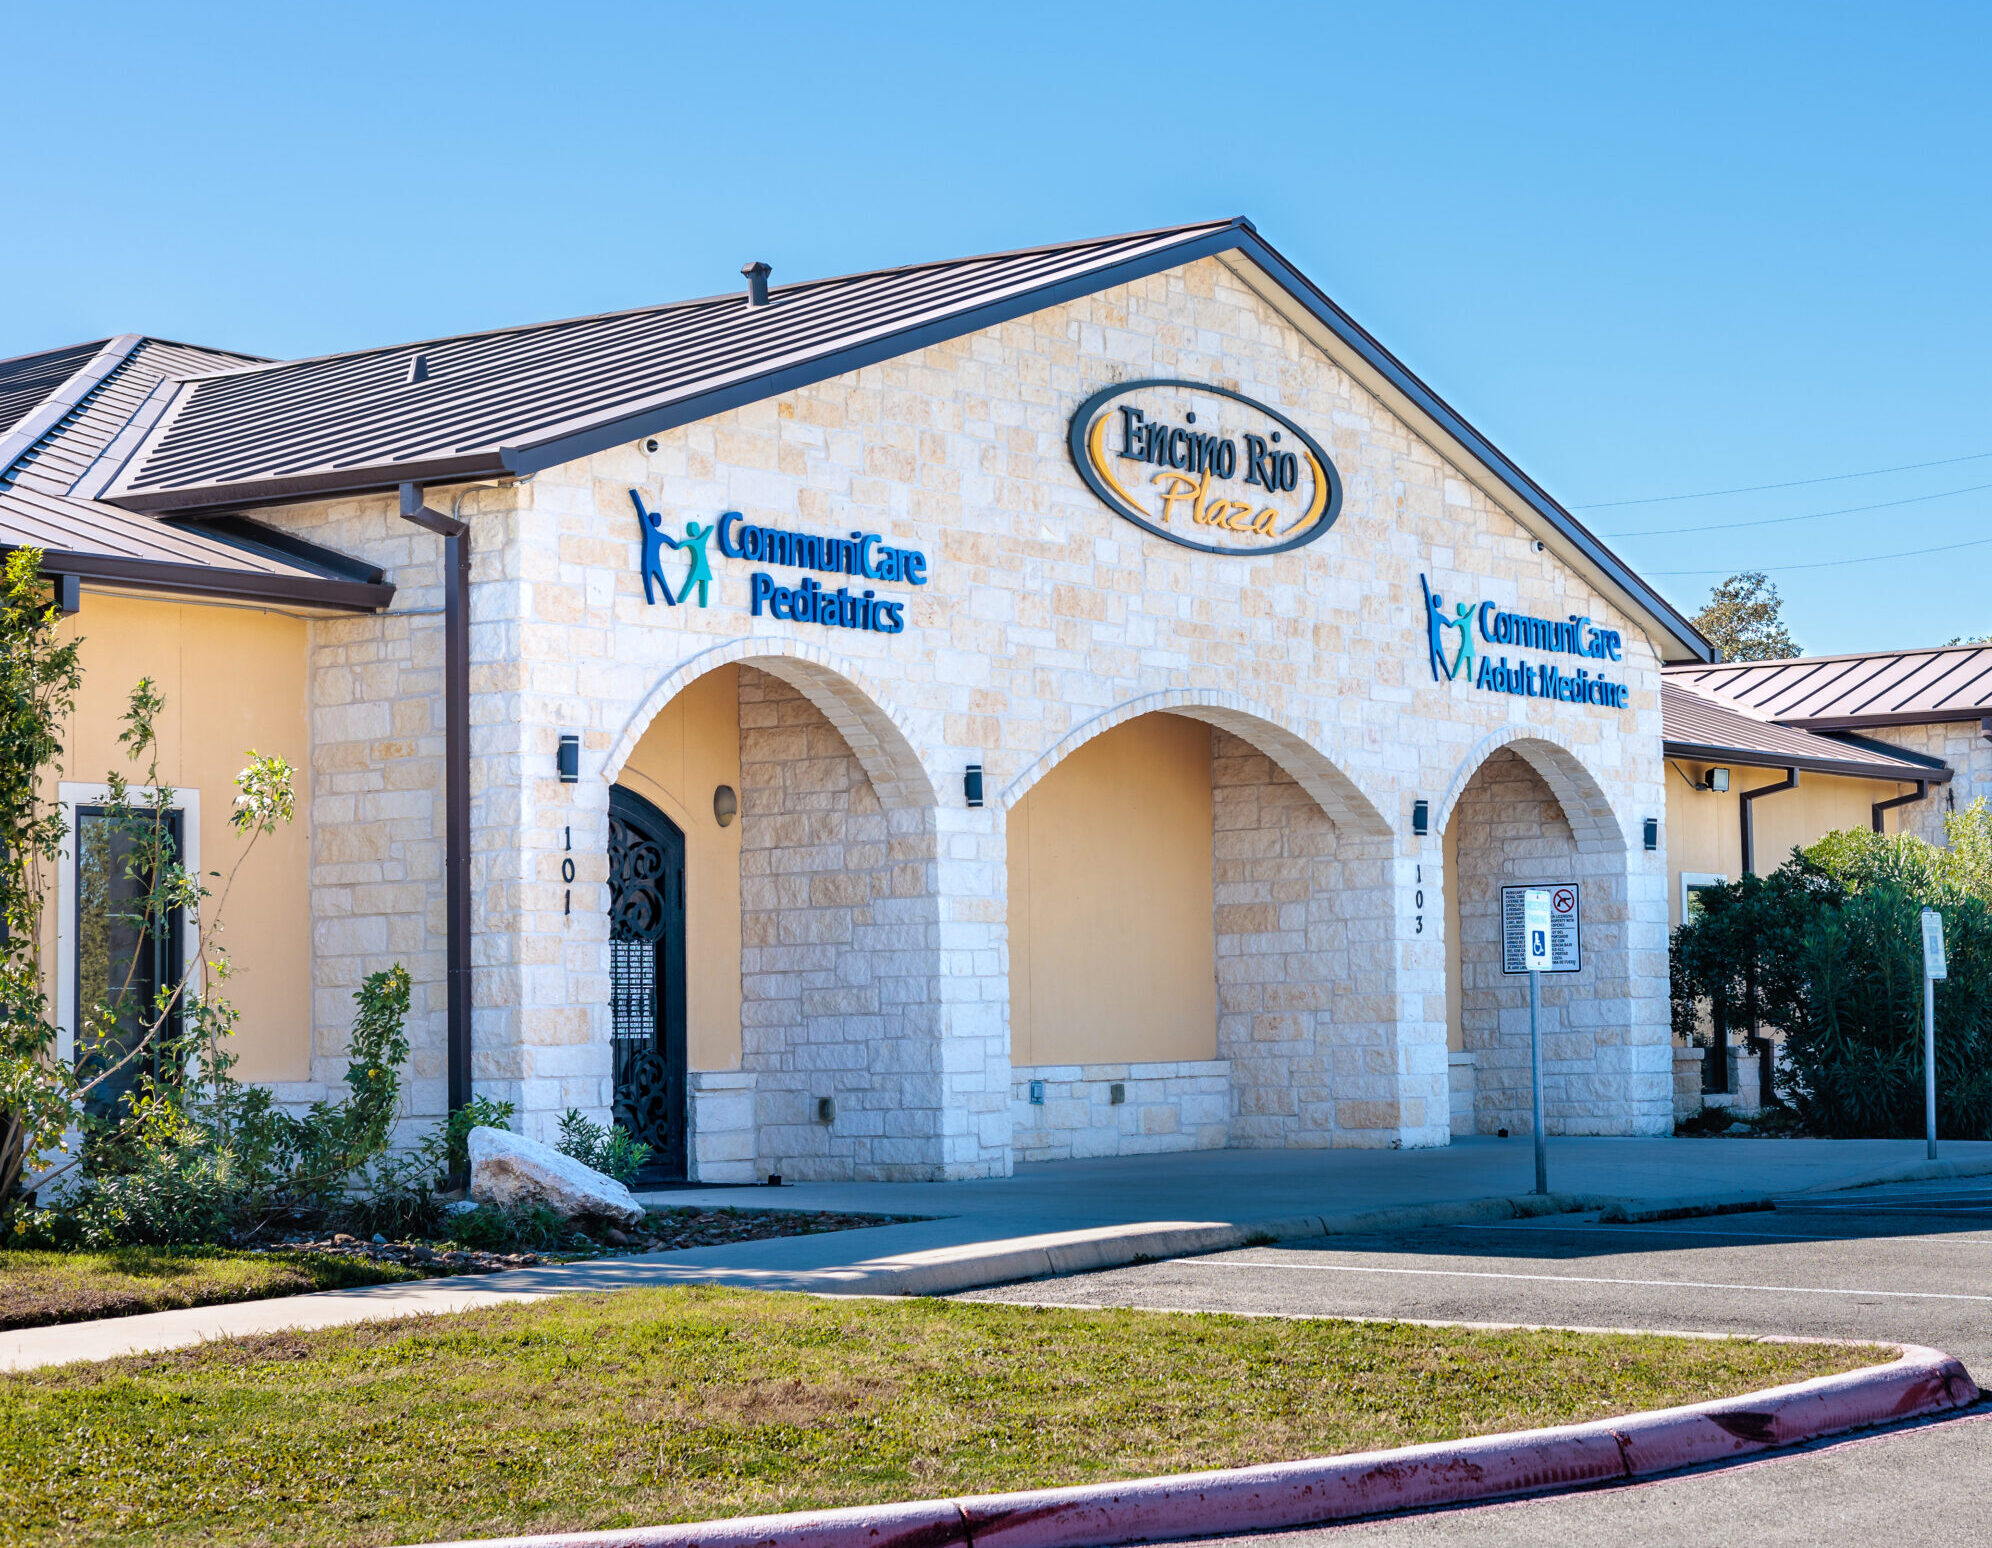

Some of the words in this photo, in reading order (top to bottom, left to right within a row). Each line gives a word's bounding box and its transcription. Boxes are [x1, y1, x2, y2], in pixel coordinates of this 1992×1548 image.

[1118, 405, 1237, 480] Encino
[1244, 431, 1299, 493] Rio
[1152, 467, 1279, 538] Plaza
[717, 511, 928, 586] CommuniCare
[751, 572, 905, 634] Pediatrics
[1478, 600, 1622, 662] CommuniCare
[1476, 655, 1538, 697] Adult
[1539, 663, 1630, 709] Medicine
[562, 826, 575, 915] 101
[1415, 864, 1424, 933] 103
